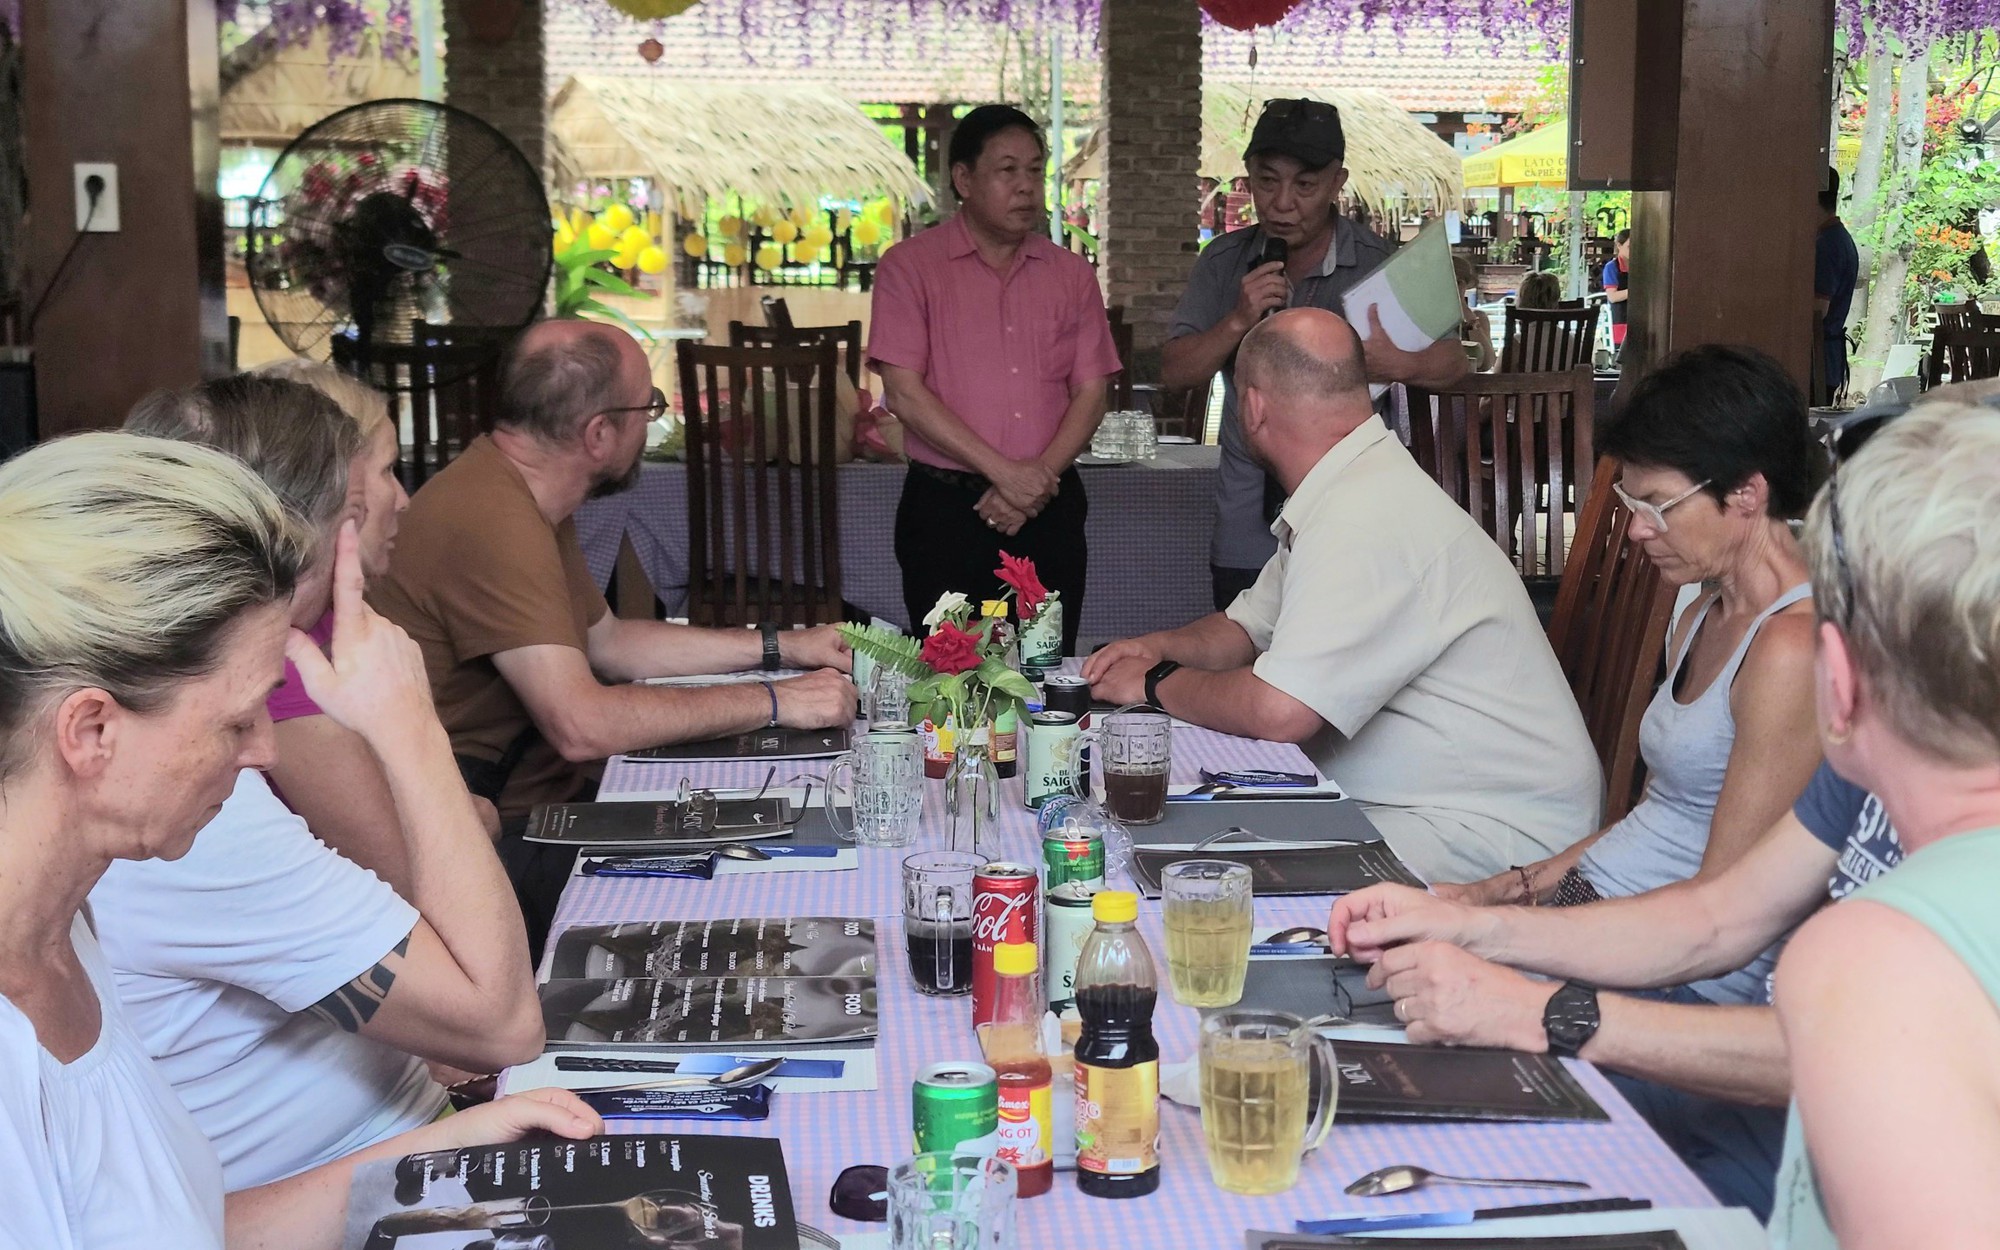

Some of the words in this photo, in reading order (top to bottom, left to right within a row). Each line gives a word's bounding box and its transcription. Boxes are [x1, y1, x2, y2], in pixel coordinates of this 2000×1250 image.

[1523, 158, 1554, 167] LATO
[1538, 167, 1555, 177] PHÊ
[845, 993, 861, 1015] FOOD
[529, 1153, 541, 1176] Passion
[564, 1150, 575, 1173] Orange
[600, 1147, 611, 1166] Carrot
[636, 1146, 647, 1168] Tomato
[668, 1144, 682, 1172] Pineapple
[419, 1165, 434, 1198] Strawberry
[458, 1160, 469, 1185] Avocado
[492, 1157, 506, 1186] Blueberry
[529, 1176, 541, 1190] fruit
[747, 1174, 777, 1228] DRINKS
